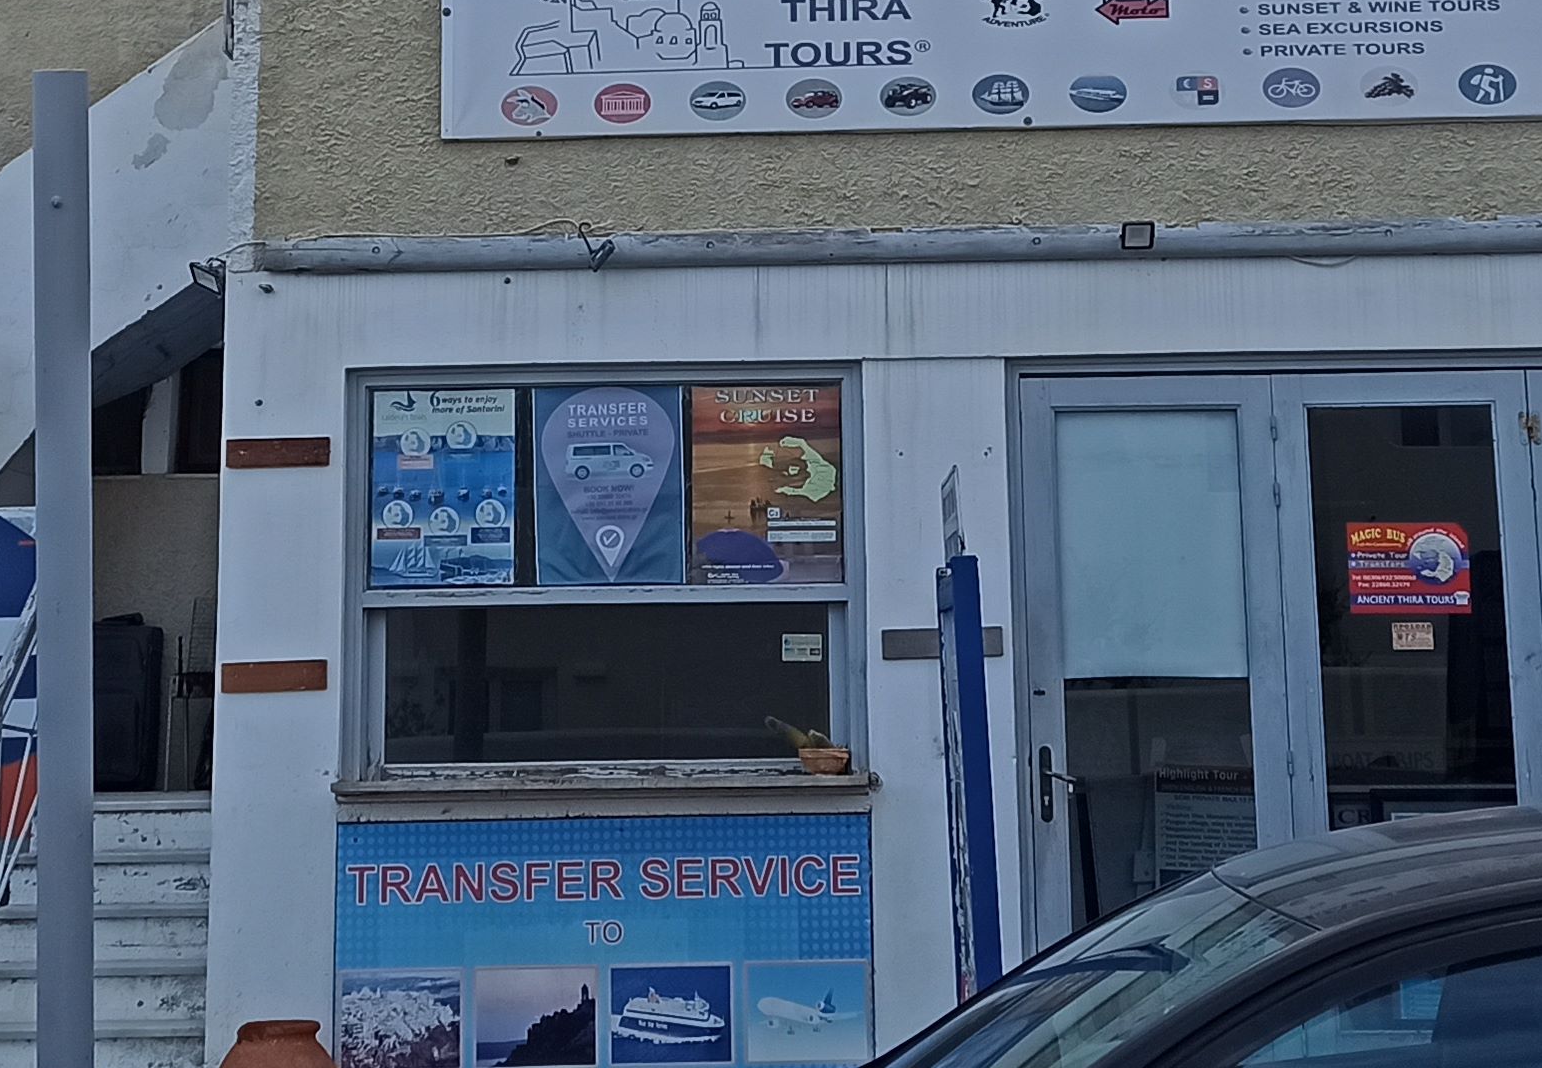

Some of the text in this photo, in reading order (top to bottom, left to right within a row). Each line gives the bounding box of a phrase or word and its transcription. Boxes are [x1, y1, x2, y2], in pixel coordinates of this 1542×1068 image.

[1110, 3, 1165, 16] Moto
[1257, 2, 1341, 15] SUNSET
[1348, 1, 1362, 14] &
[1368, 0, 1422, 13] WINE
[981, 15, 1047, 28] ADVENTURE
[1259, 20, 1443, 36] SEA EXCURSIONS
[1260, 42, 1425, 57] PRIVATE TOURS
[464, 396, 473, 404] to
[714, 388, 820, 405] SUNSET
[568, 402, 647, 416] TRANSFER
[720, 407, 816, 423] CRUISE
[567, 416, 648, 428] SERVICES
[1351, 528, 1382, 544] MAGIC
[1386, 528, 1406, 543] BUS
[1356, 552, 1386, 560] Private
[1357, 595, 1454, 604] ANCIENT THIRA TOURS
[1159, 767, 1240, 781] Highlight Tour
[347, 854, 861, 905] TRANSFER SERVICE
[583, 920, 624, 945] TO
